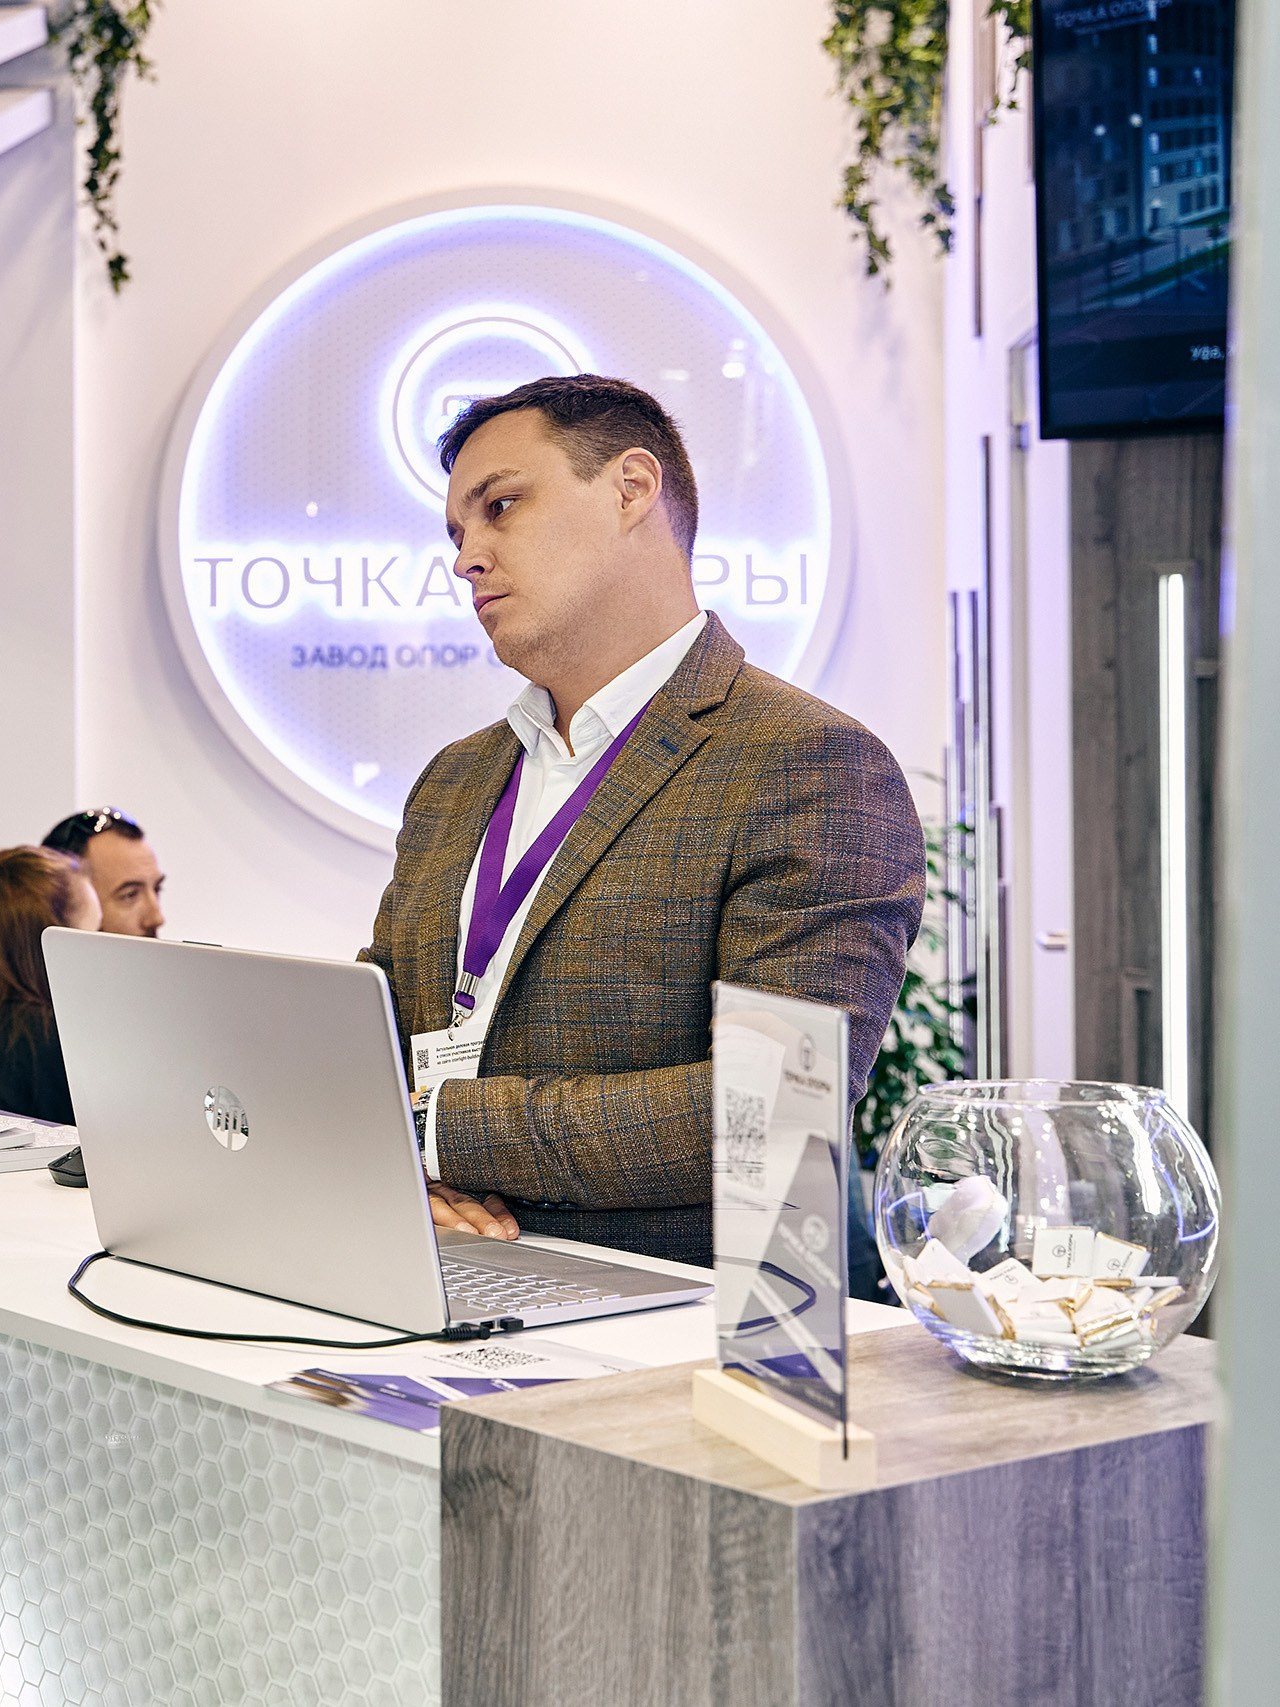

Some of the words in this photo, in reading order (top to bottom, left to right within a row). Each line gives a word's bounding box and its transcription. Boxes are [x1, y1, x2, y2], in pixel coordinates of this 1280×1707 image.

[193, 556, 461, 609] ТОЧКА
[291, 645, 388, 670] ЗАВОД
[395, 645, 480, 669] ОПОР
